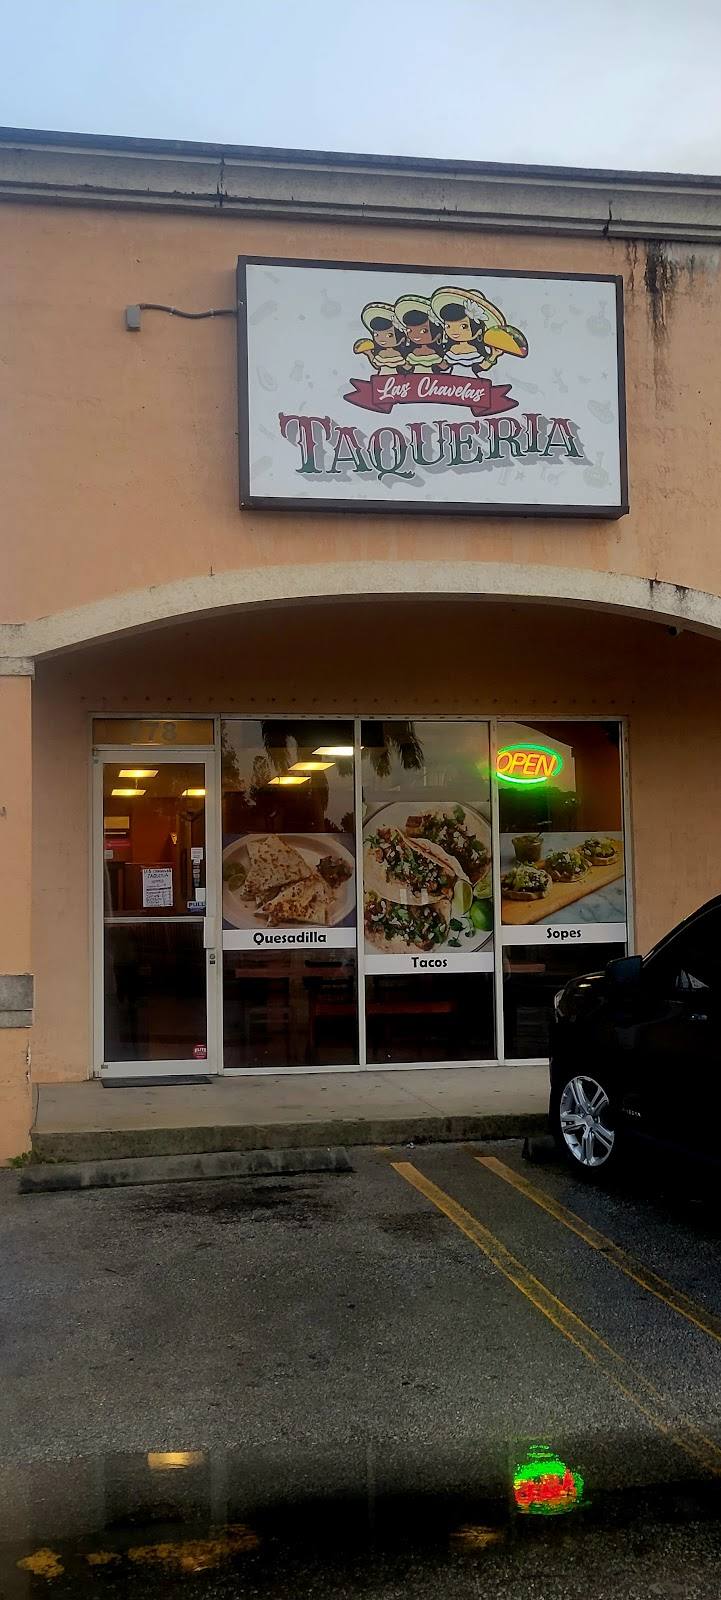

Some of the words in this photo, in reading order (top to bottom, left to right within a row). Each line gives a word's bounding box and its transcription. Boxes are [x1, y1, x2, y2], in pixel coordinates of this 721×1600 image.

[376, 377, 411, 400] Las
[418, 378, 486, 401] Chavelas
[278, 412, 584, 481] TAQUERIA
[496, 751, 557, 776] OPEN
[253, 932, 327, 945] Quesadilla
[546, 927, 582, 940] Sopes
[411, 957, 448, 968] Tacos
